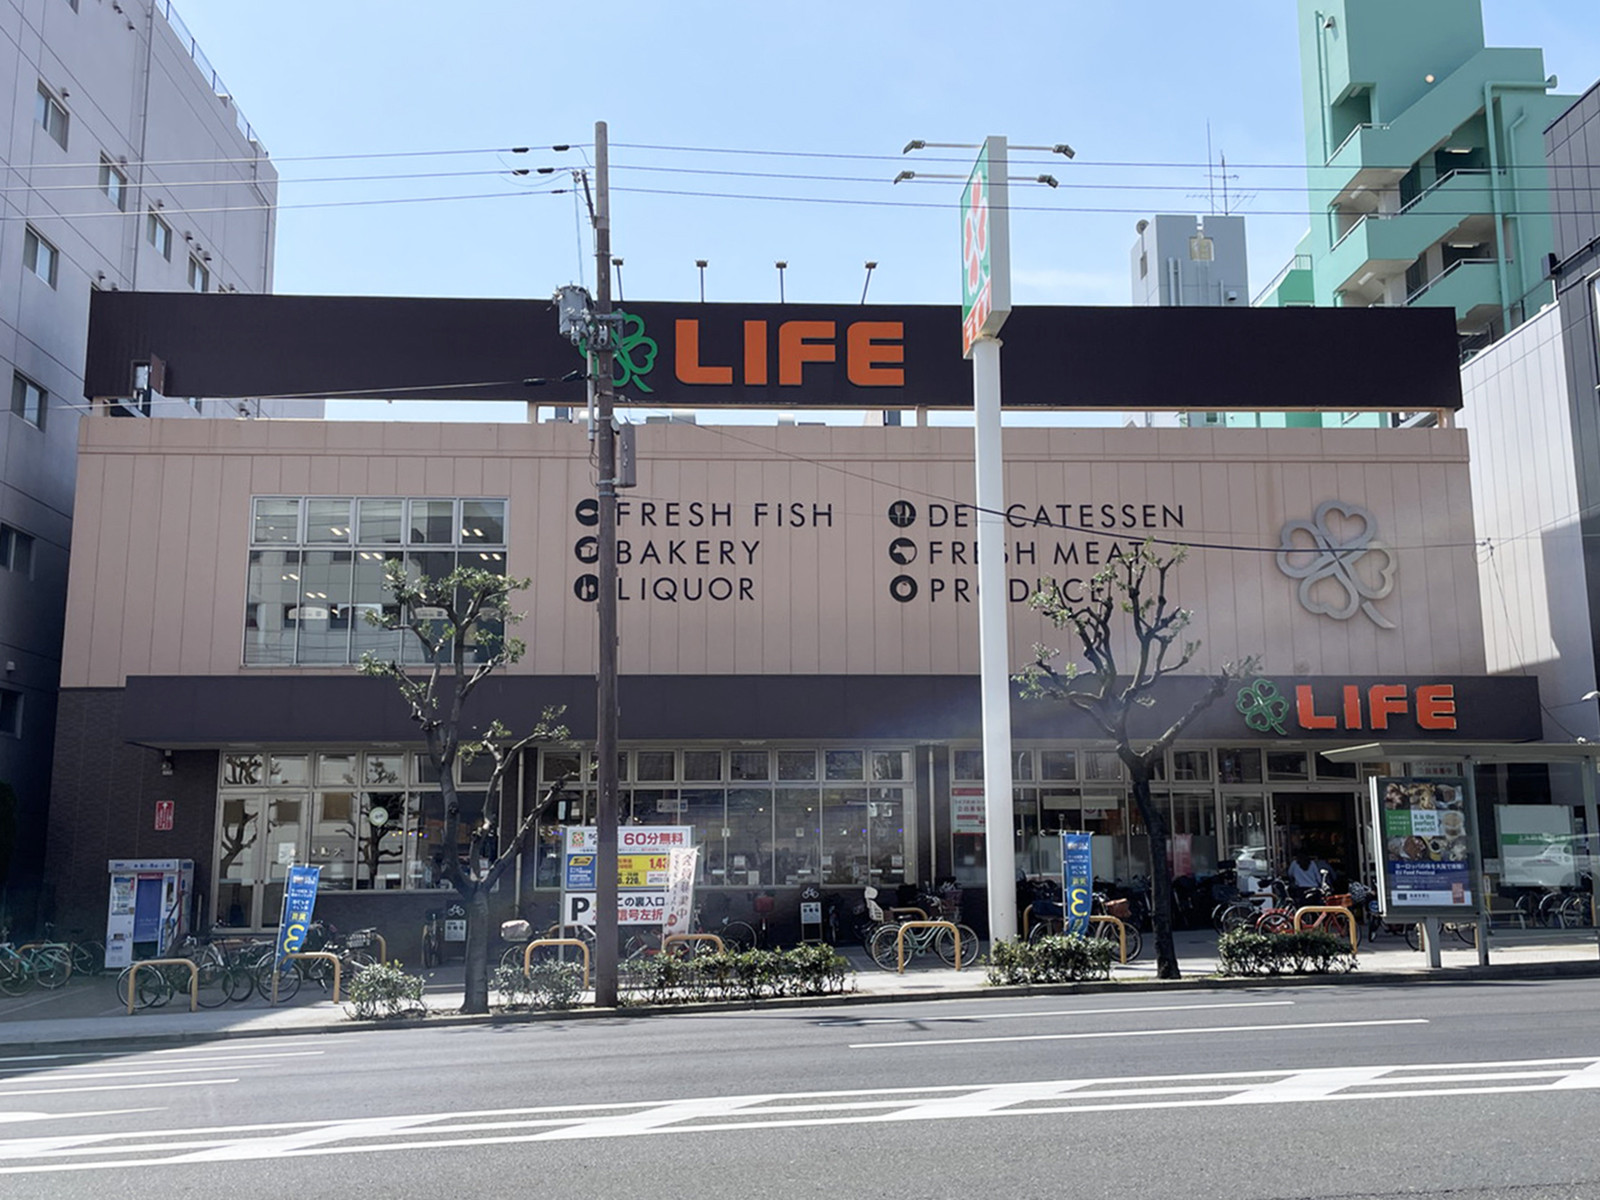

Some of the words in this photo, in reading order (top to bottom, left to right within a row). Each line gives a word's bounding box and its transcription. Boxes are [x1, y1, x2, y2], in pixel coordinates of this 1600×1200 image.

[675, 319, 904, 387] LIFE
[617, 502, 731, 527] FRESH
[755, 503, 832, 527] FISH
[928, 504, 1184, 528] DECATESSEN
[616, 540, 760, 564] BAKERY
[929, 541, 1035, 565] FRH
[1053, 541, 1144, 565] MEAT
[618, 577, 754, 602] LIQUOR
[931, 578, 1104, 603] PRDUCE
[1296, 684, 1457, 730] LIFE
[624, 832, 684, 845] 60分無料
[571, 897, 590, 921] P
